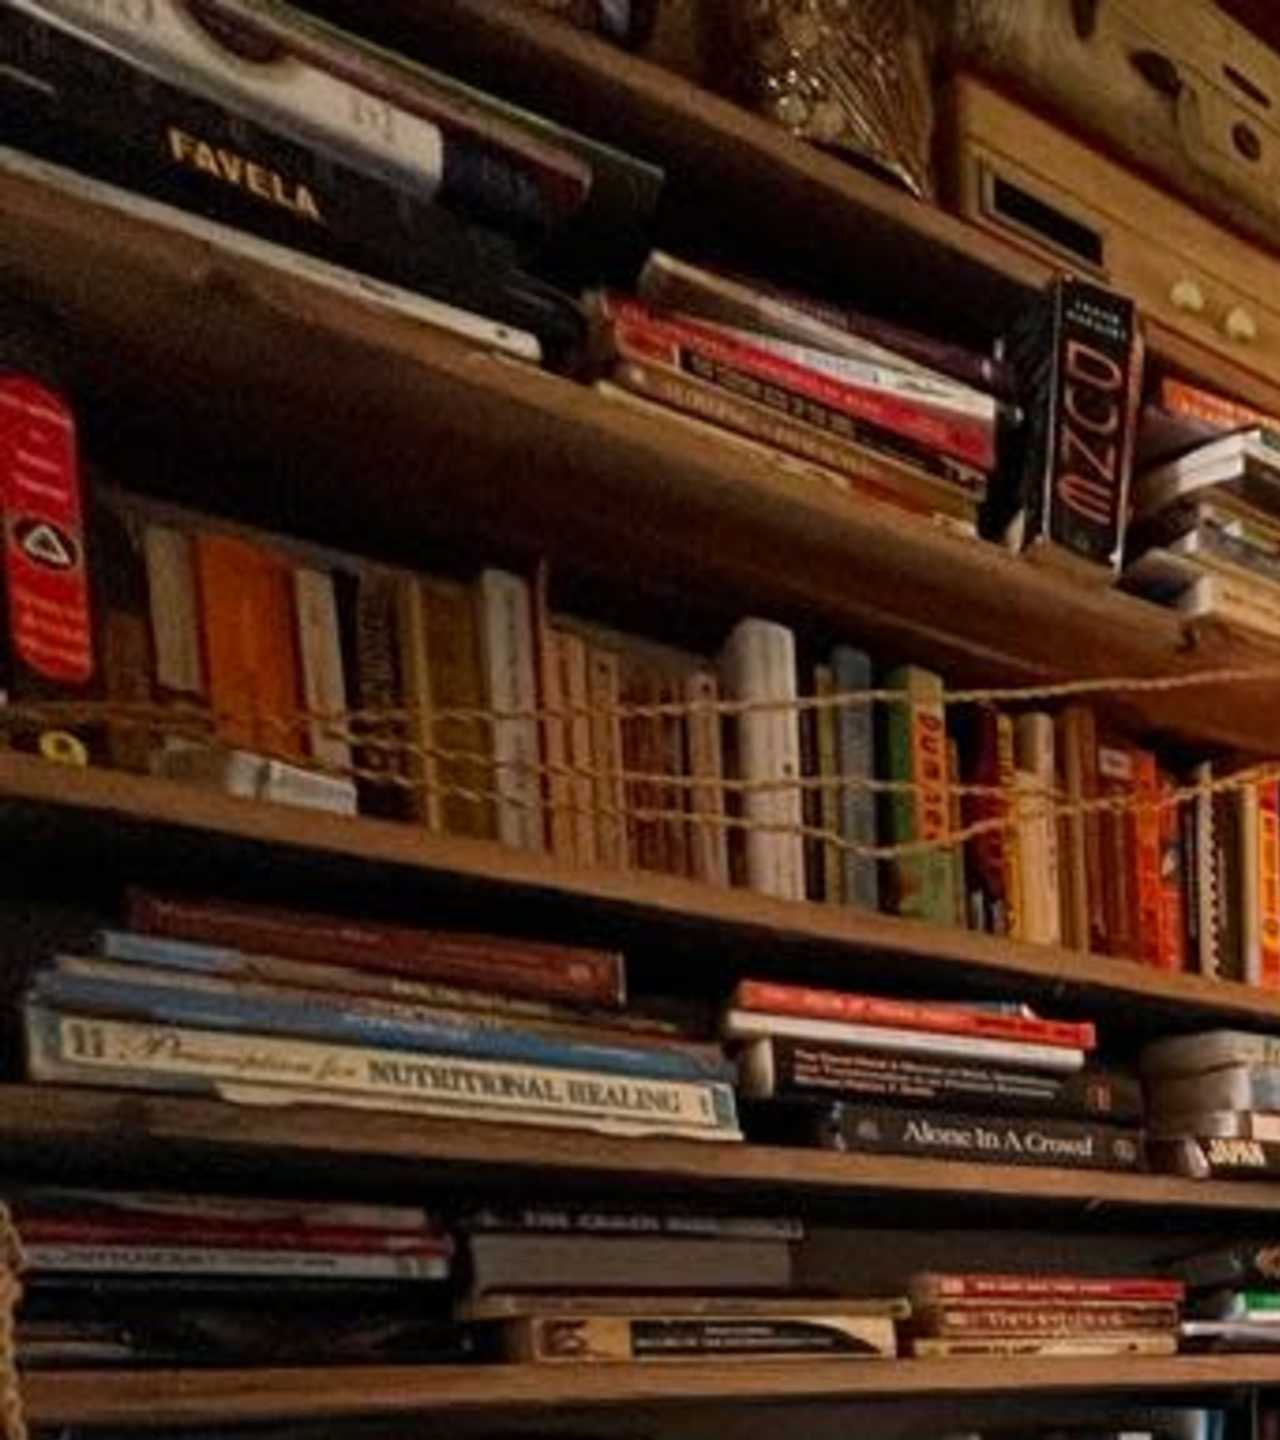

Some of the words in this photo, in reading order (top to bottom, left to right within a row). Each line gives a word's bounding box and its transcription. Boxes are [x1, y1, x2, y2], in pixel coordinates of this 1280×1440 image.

[168, 127, 323, 222] FAVELA
[367, 1055, 562, 1104] NUTRITIONAL
[568, 1080, 682, 1115] HEALING
[903, 1119, 973, 1148] Alone
[976, 1128, 1000, 1149] In
[1003, 1130, 1025, 1151] A
[1025, 1131, 1094, 1157] Crowd
